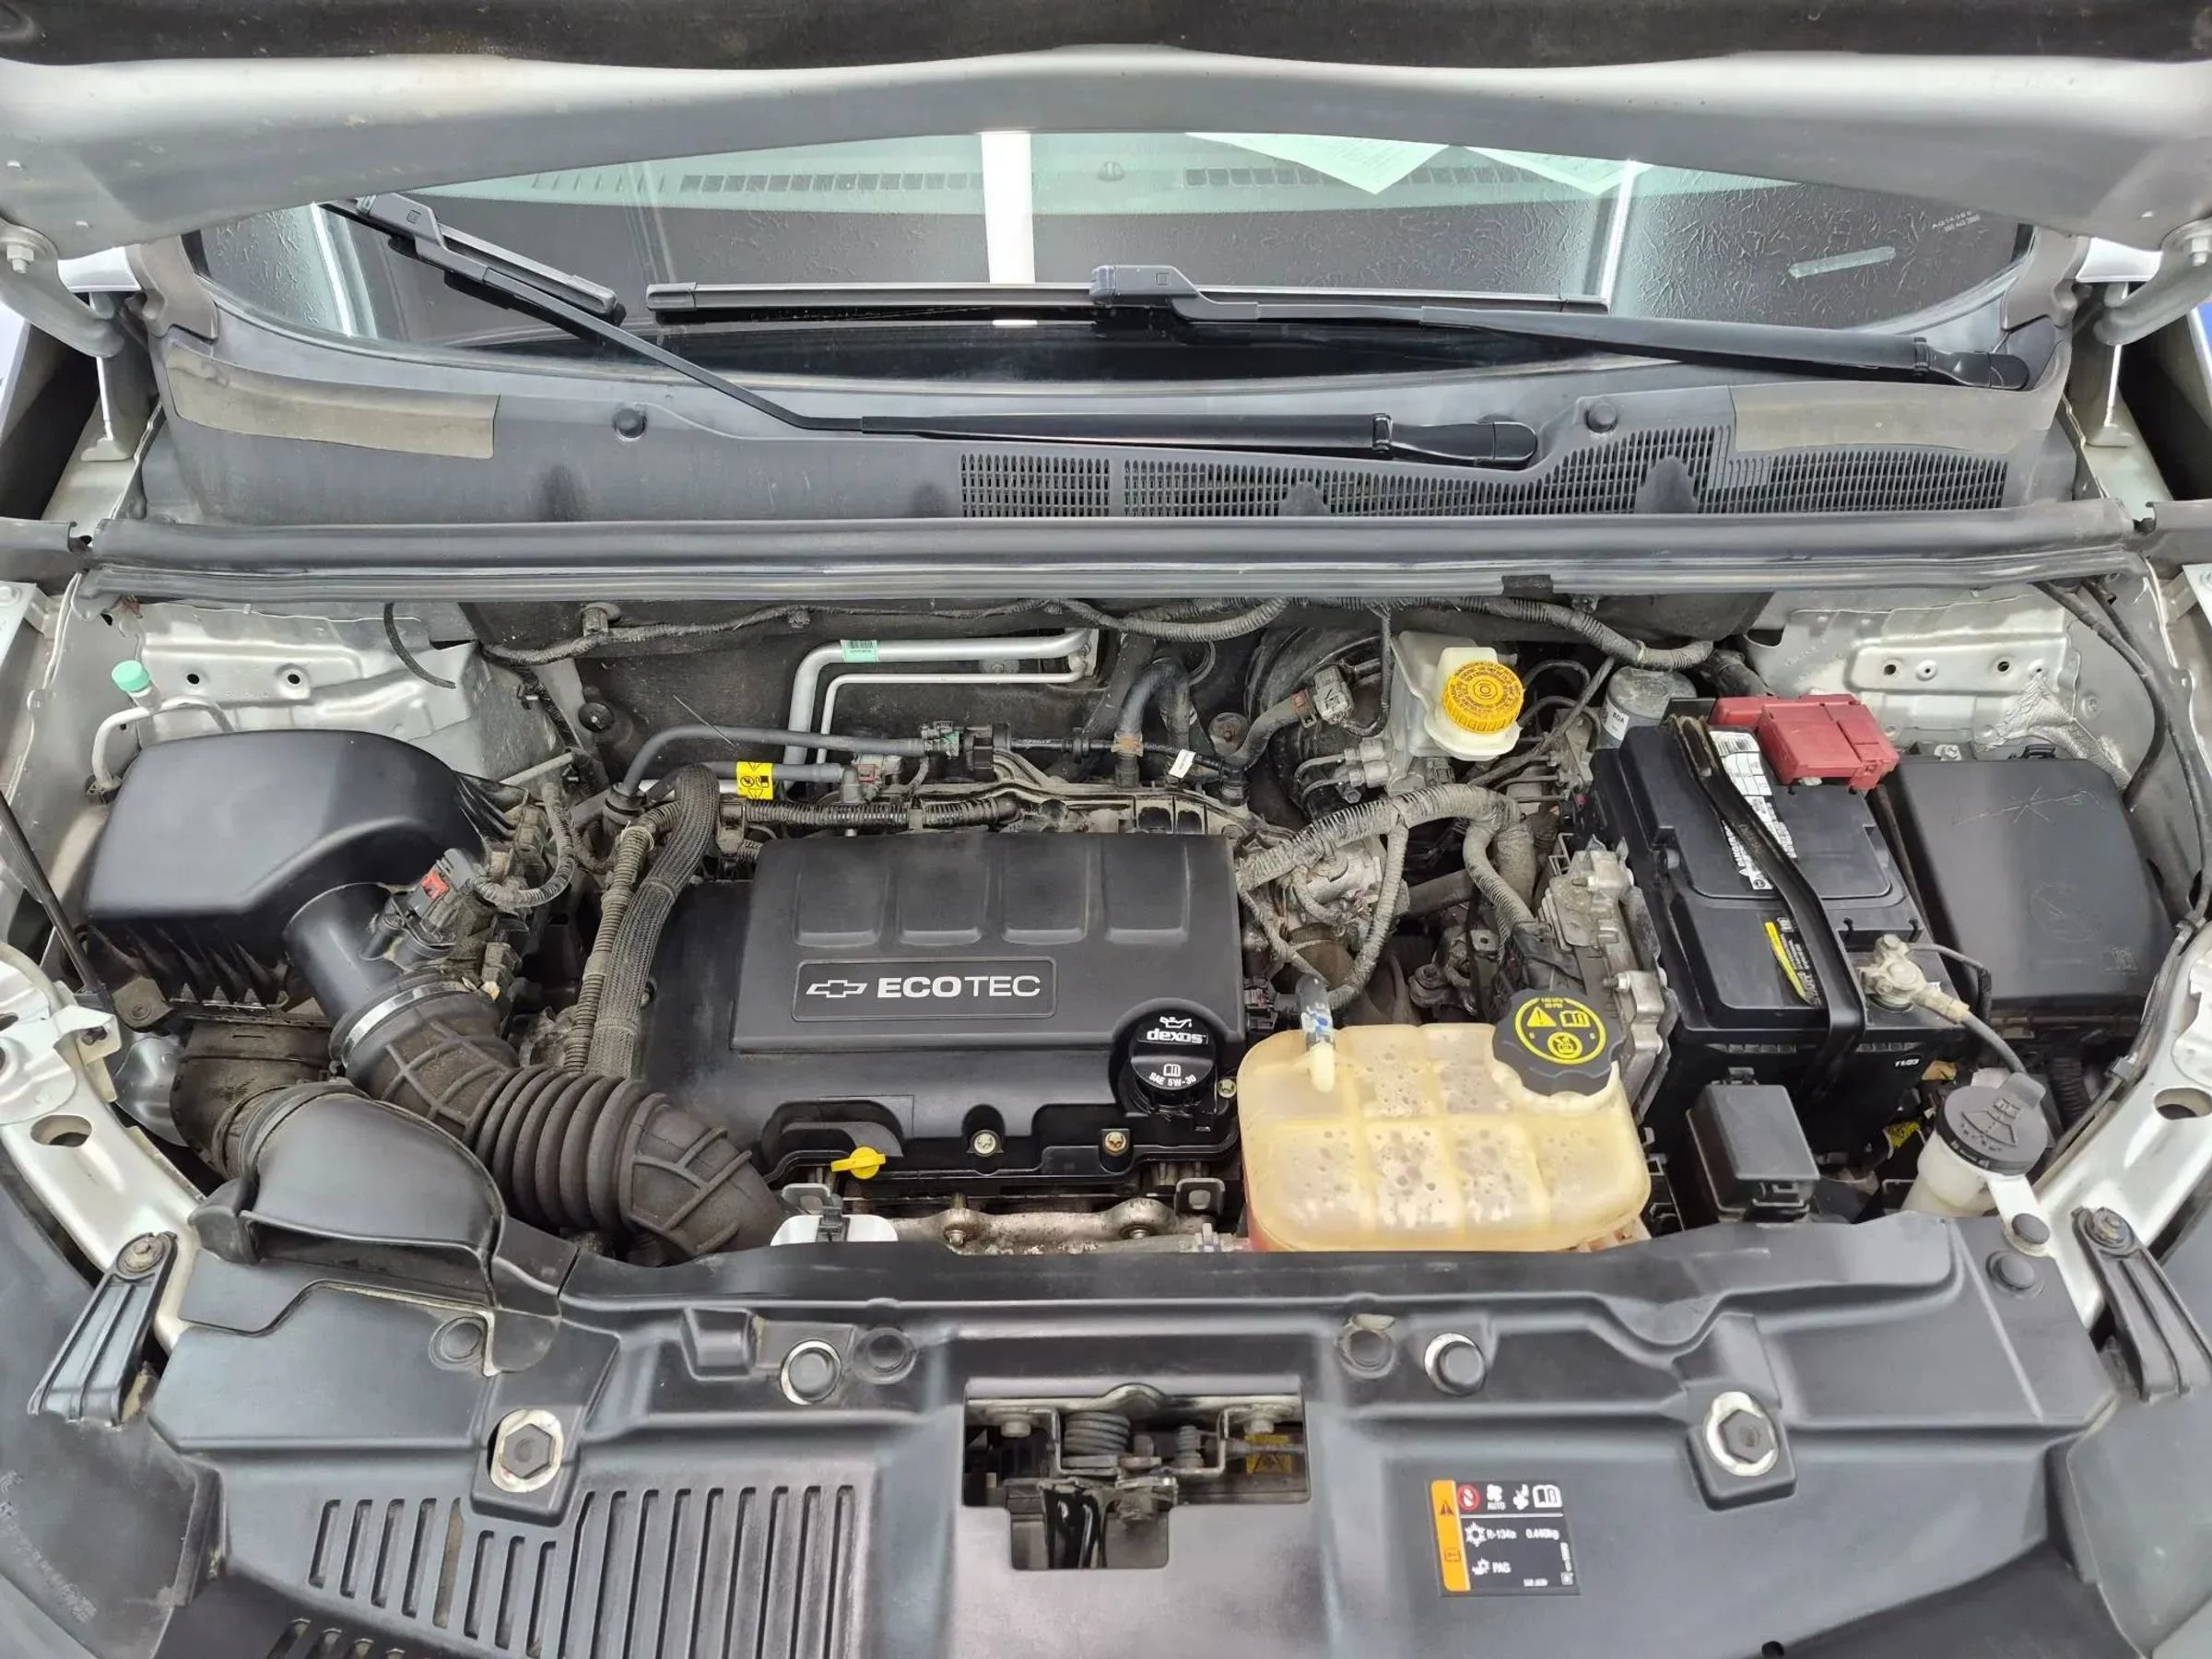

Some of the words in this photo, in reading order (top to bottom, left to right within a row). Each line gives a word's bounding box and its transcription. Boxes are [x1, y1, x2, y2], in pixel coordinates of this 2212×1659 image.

[877, 975, 1041, 998] ECOTEC
[1147, 1028, 1203, 1044] dexos
[1148, 1072, 1166, 1086] SAE
[1168, 1074, 1196, 1087] 5W-30
[1487, 1501, 1506, 1511] AUTO
[1492, 1561, 1512, 1573] PAG
